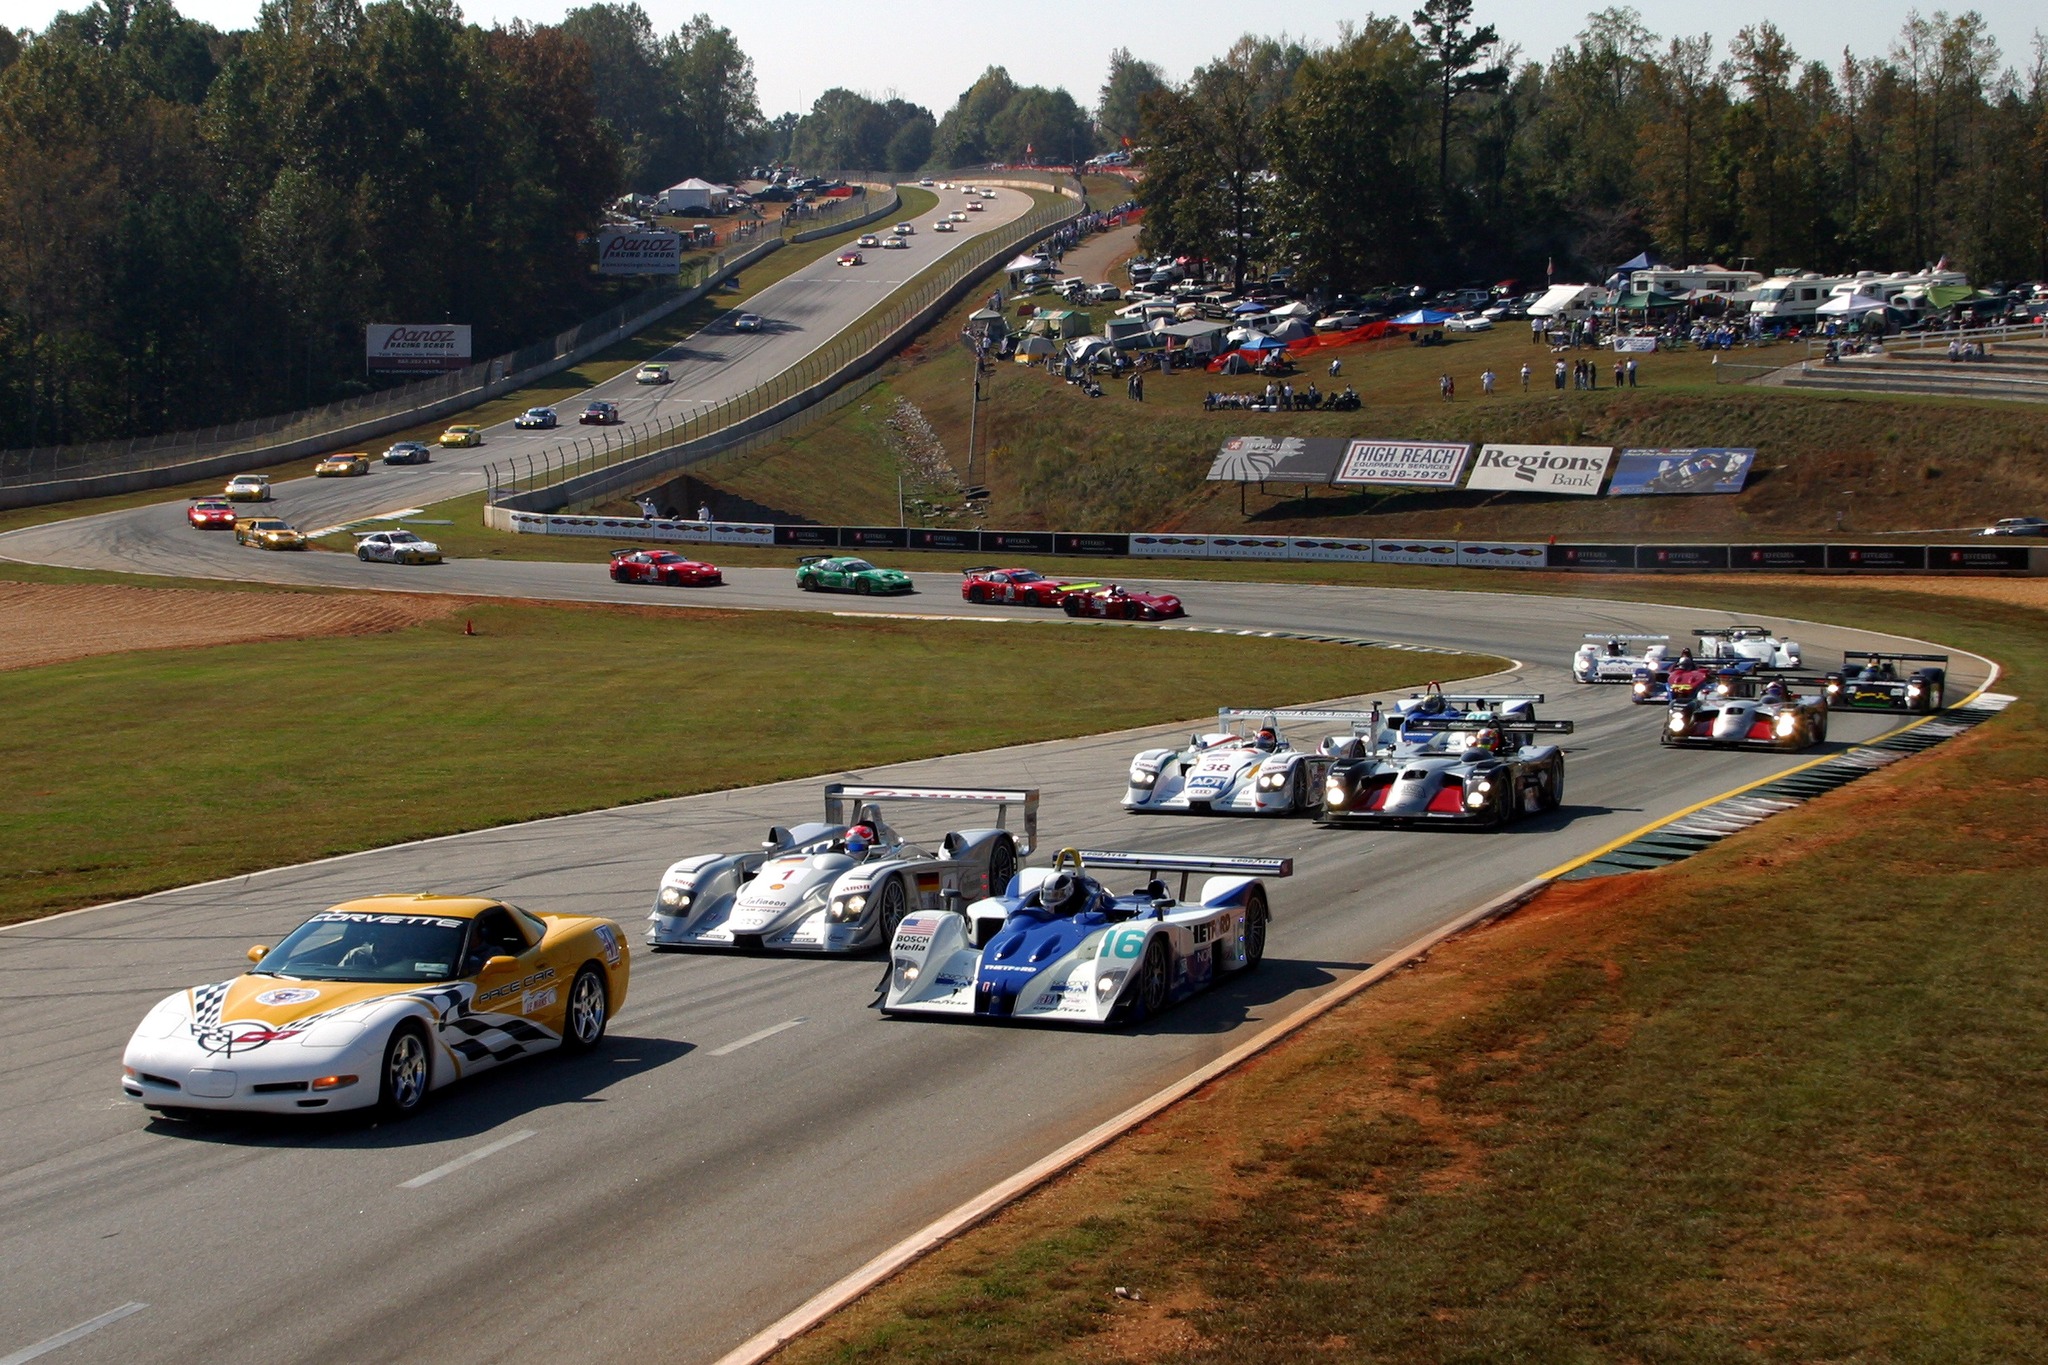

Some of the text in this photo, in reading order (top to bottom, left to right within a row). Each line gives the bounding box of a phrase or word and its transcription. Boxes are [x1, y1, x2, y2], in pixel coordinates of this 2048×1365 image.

[1356, 446, 1456, 464] HIGH REACH
[1353, 461, 1406, 469] EQUIPMENT
[1479, 449, 1604, 481] Regions
[1350, 468, 1447, 479] 770 638-7979
[1551, 473, 1594, 487] Bank
[1202, 763, 1231, 772] 38
[1189, 777, 1225, 787] ADT
[782, 869, 796, 881] 1
[307, 913, 464, 929] CORVETTE
[896, 935, 930, 943] BOSCH
[1100, 930, 1146, 958] 16
[478, 967, 555, 1004] PACE CAR
